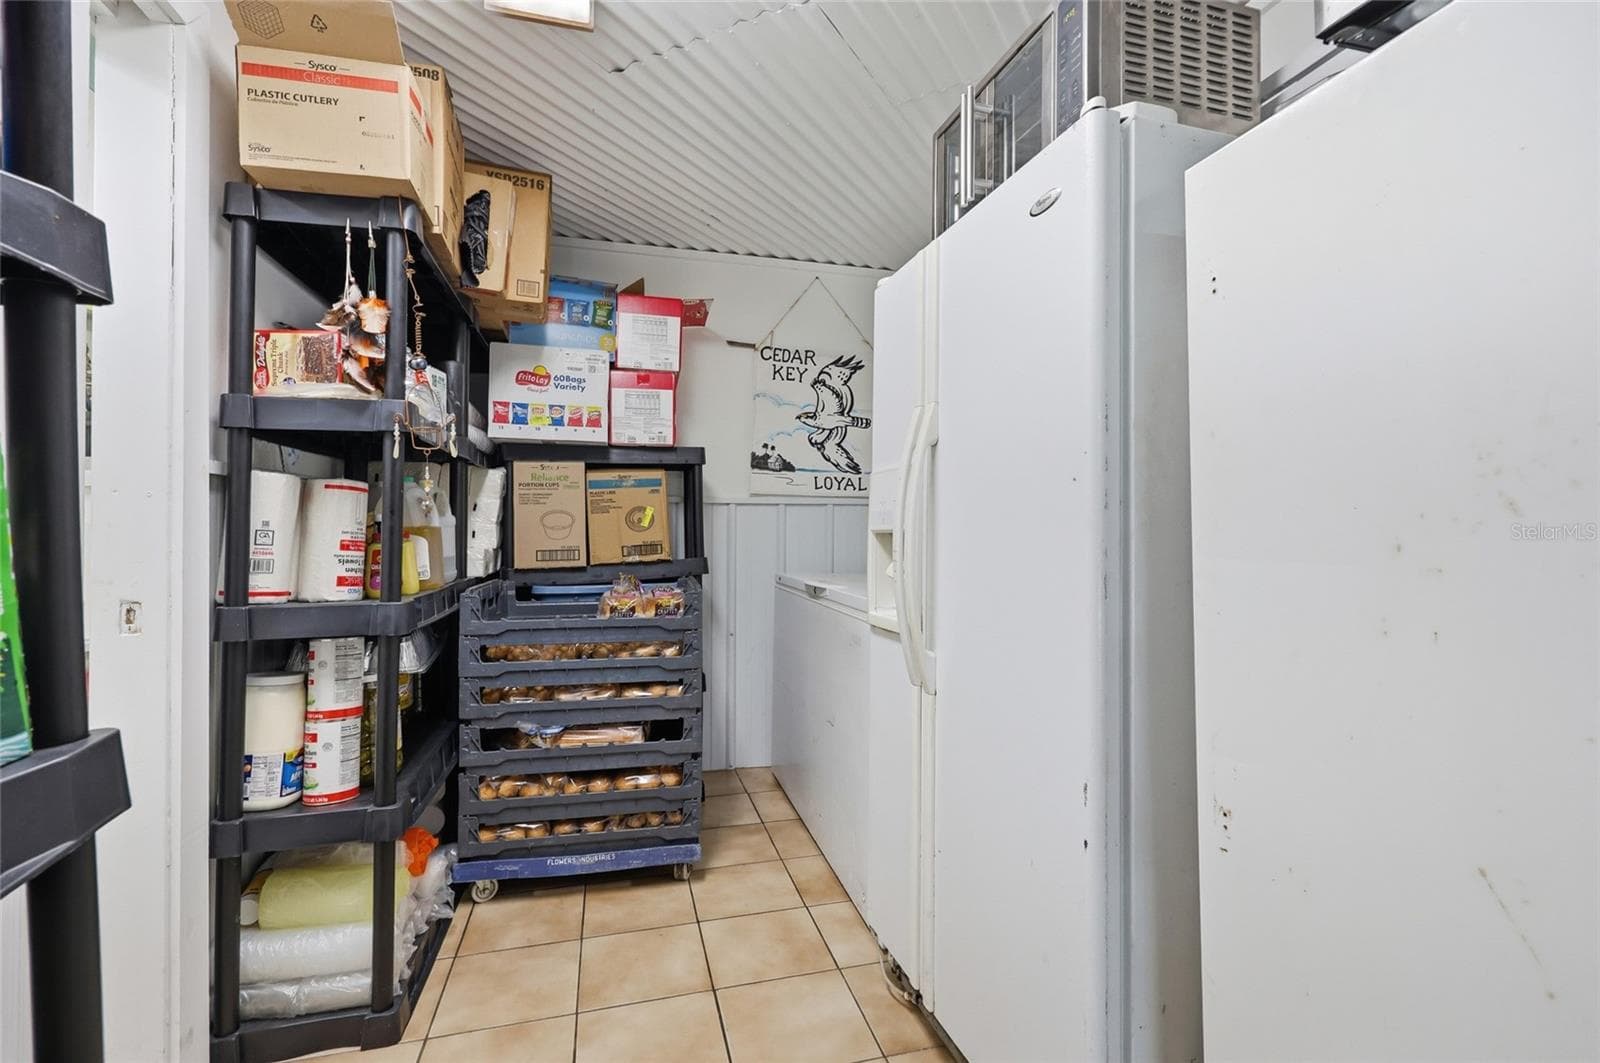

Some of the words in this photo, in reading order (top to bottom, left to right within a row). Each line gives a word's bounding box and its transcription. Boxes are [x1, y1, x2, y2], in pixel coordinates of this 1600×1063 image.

[308, 60, 337, 71] Sysco
[303, 71, 342, 85] Classic
[247, 88, 291, 101] PLASTIC
[293, 93, 339, 106] CUTLERY
[248, 143, 271, 153] Sysco
[760, 346, 817, 366] CEDAR
[772, 364, 808, 383] KEY
[553, 382, 586, 392] Variety
[814, 476, 867, 491] LOYAL
[547, 856, 576, 866] FLOWERS
[578, 853, 616, 864] INDUSTRIES
